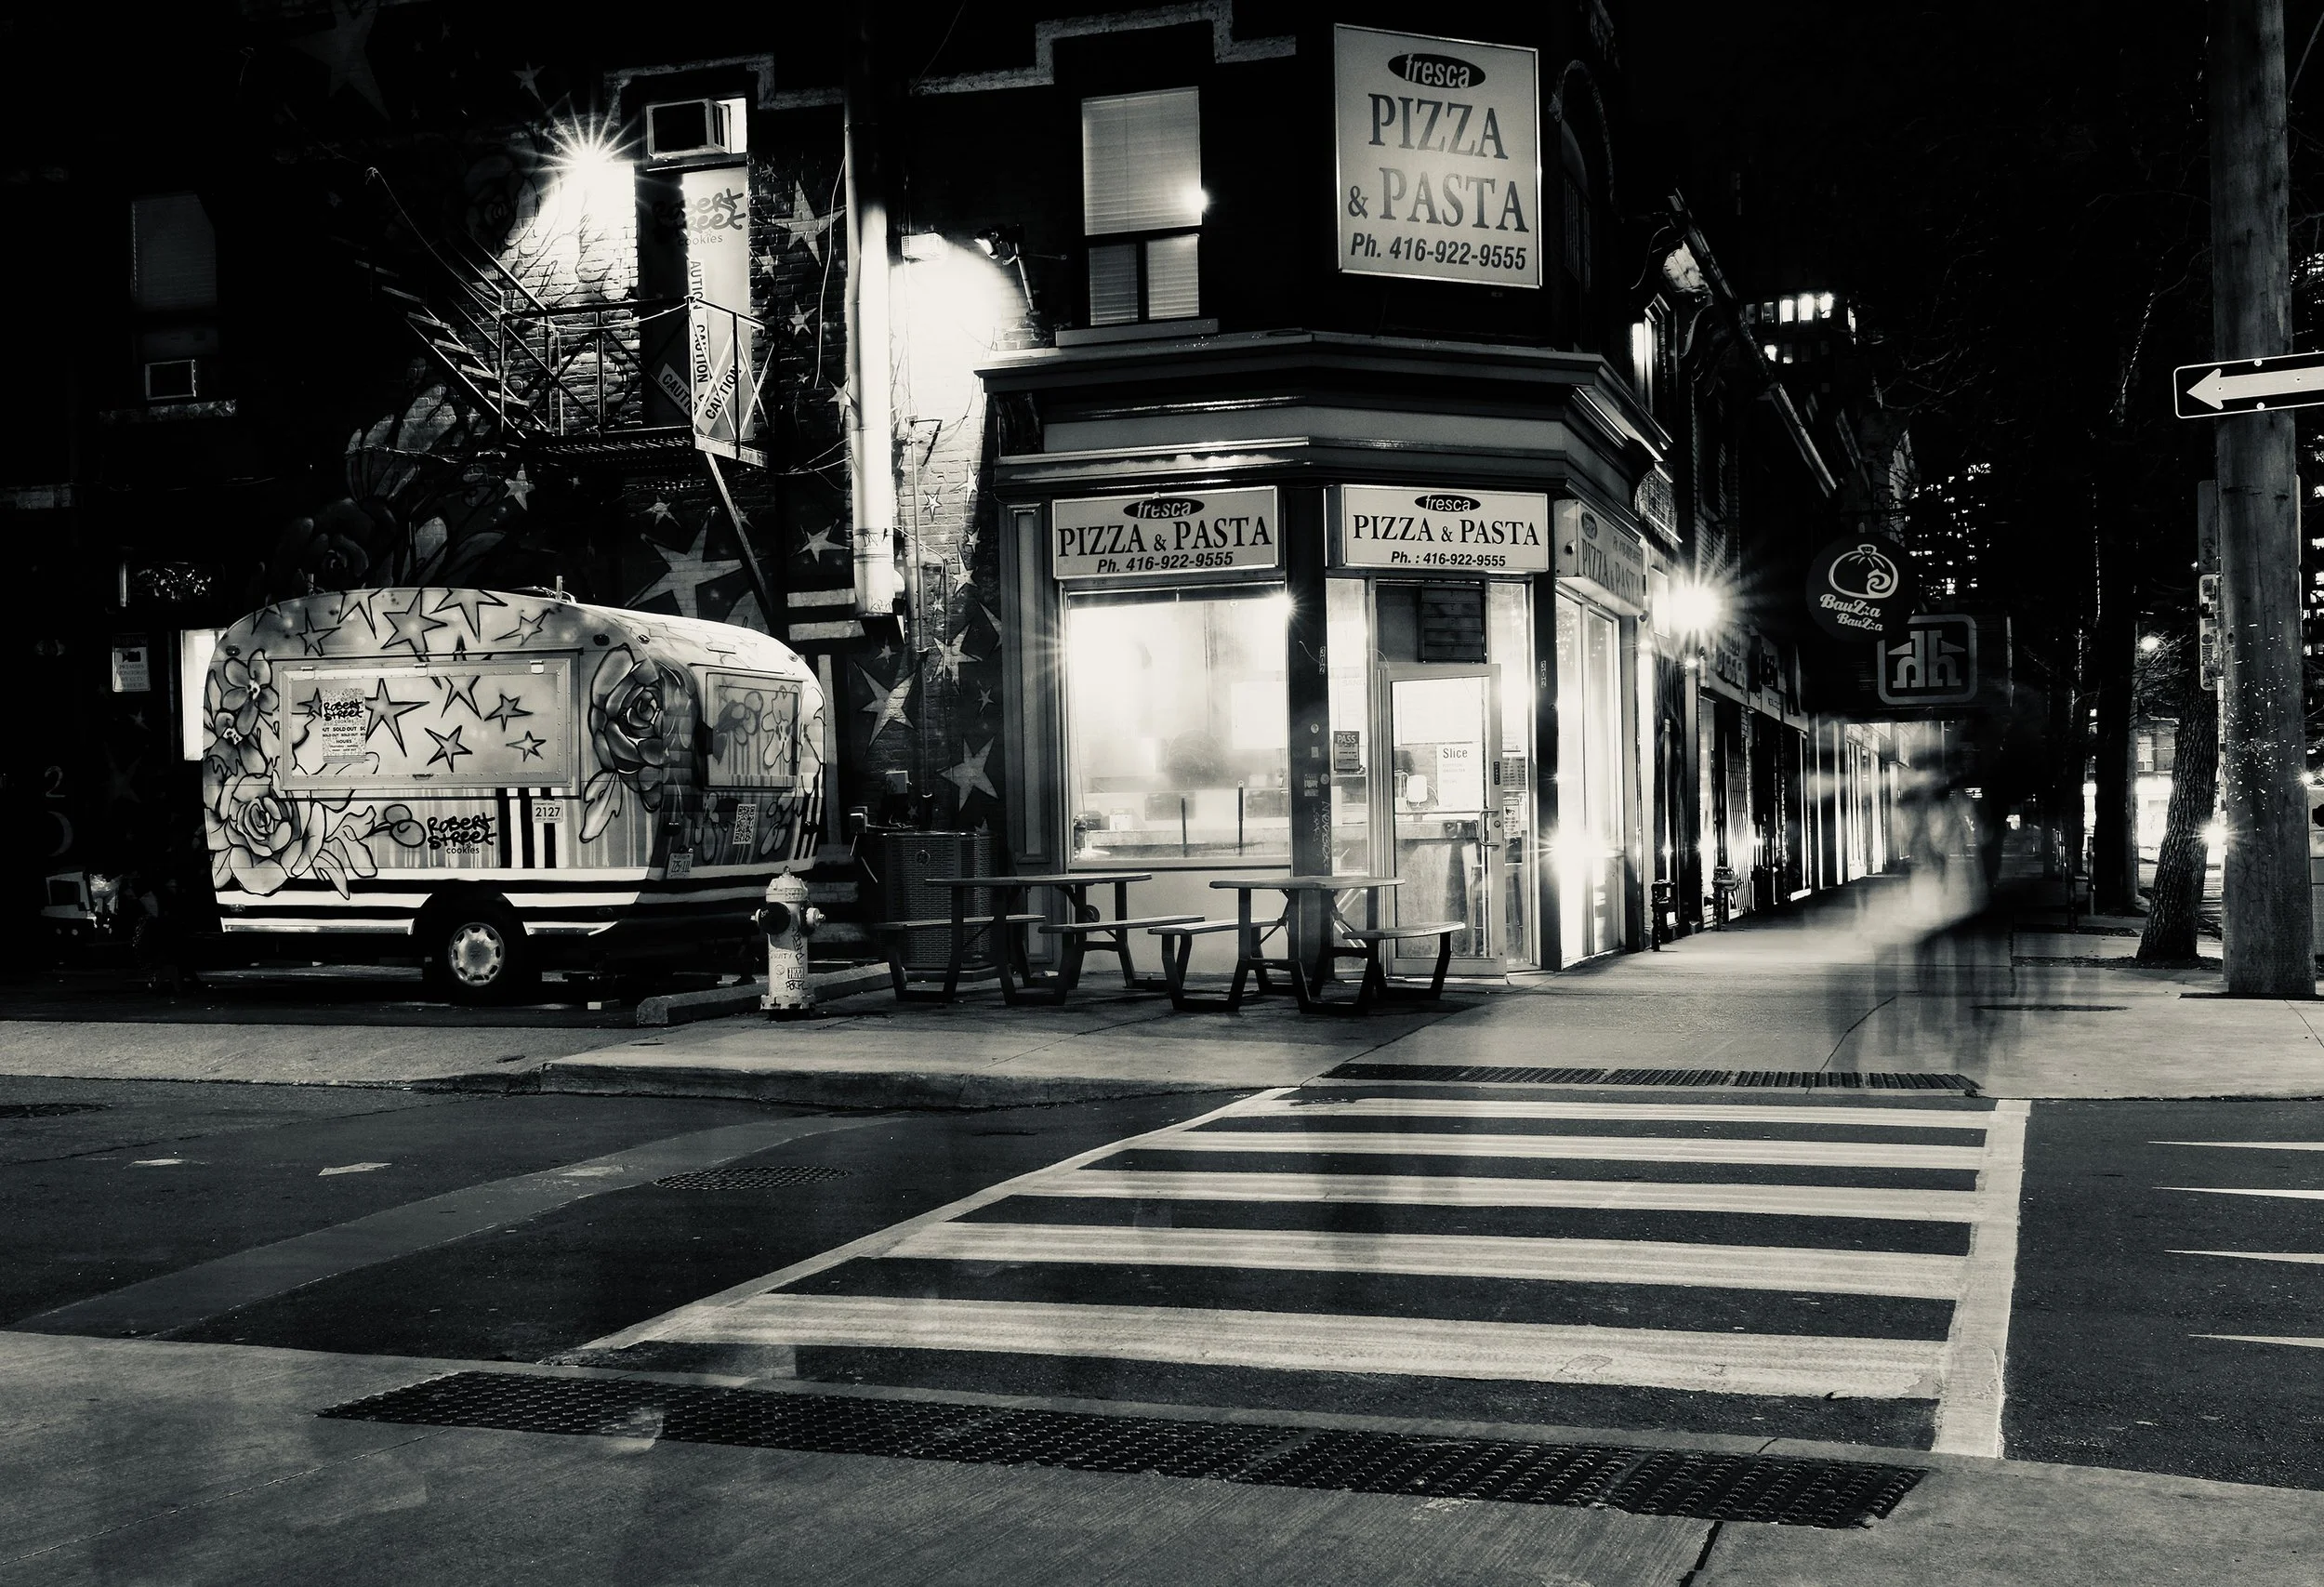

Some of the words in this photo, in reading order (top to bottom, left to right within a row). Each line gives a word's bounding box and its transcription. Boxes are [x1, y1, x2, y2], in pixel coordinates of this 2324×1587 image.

[1405, 53, 1471, 88] fresca
[1368, 93, 1509, 160] PIZZA
[1348, 185, 1368, 219] &
[1379, 166, 1530, 233] PASTA
[1351, 231, 1381, 258] Ph.
[1389, 235, 1527, 271] 416-922-9555
[1137, 500, 1192, 518] fresca
[1425, 494, 1472, 511] fresca
[1058, 522, 1147, 557] PIZZA
[1153, 534, 1167, 552] &
[1173, 516, 1273, 550] PASTA
[1353, 514, 1434, 542] PIZZA
[1441, 525, 1453, 542] &
[1459, 518, 1541, 546] PASTA
[1097, 558, 1120, 573] Ph.
[1126, 550, 1235, 570] 416-922-9555
[1423, 552, 1507, 567] 416-922-9555
[1337, 734, 1356, 744] PASS
[1443, 747, 1468, 759] Slice
[535, 806, 561, 817] 2127
[446, 845, 480, 854] cookies
